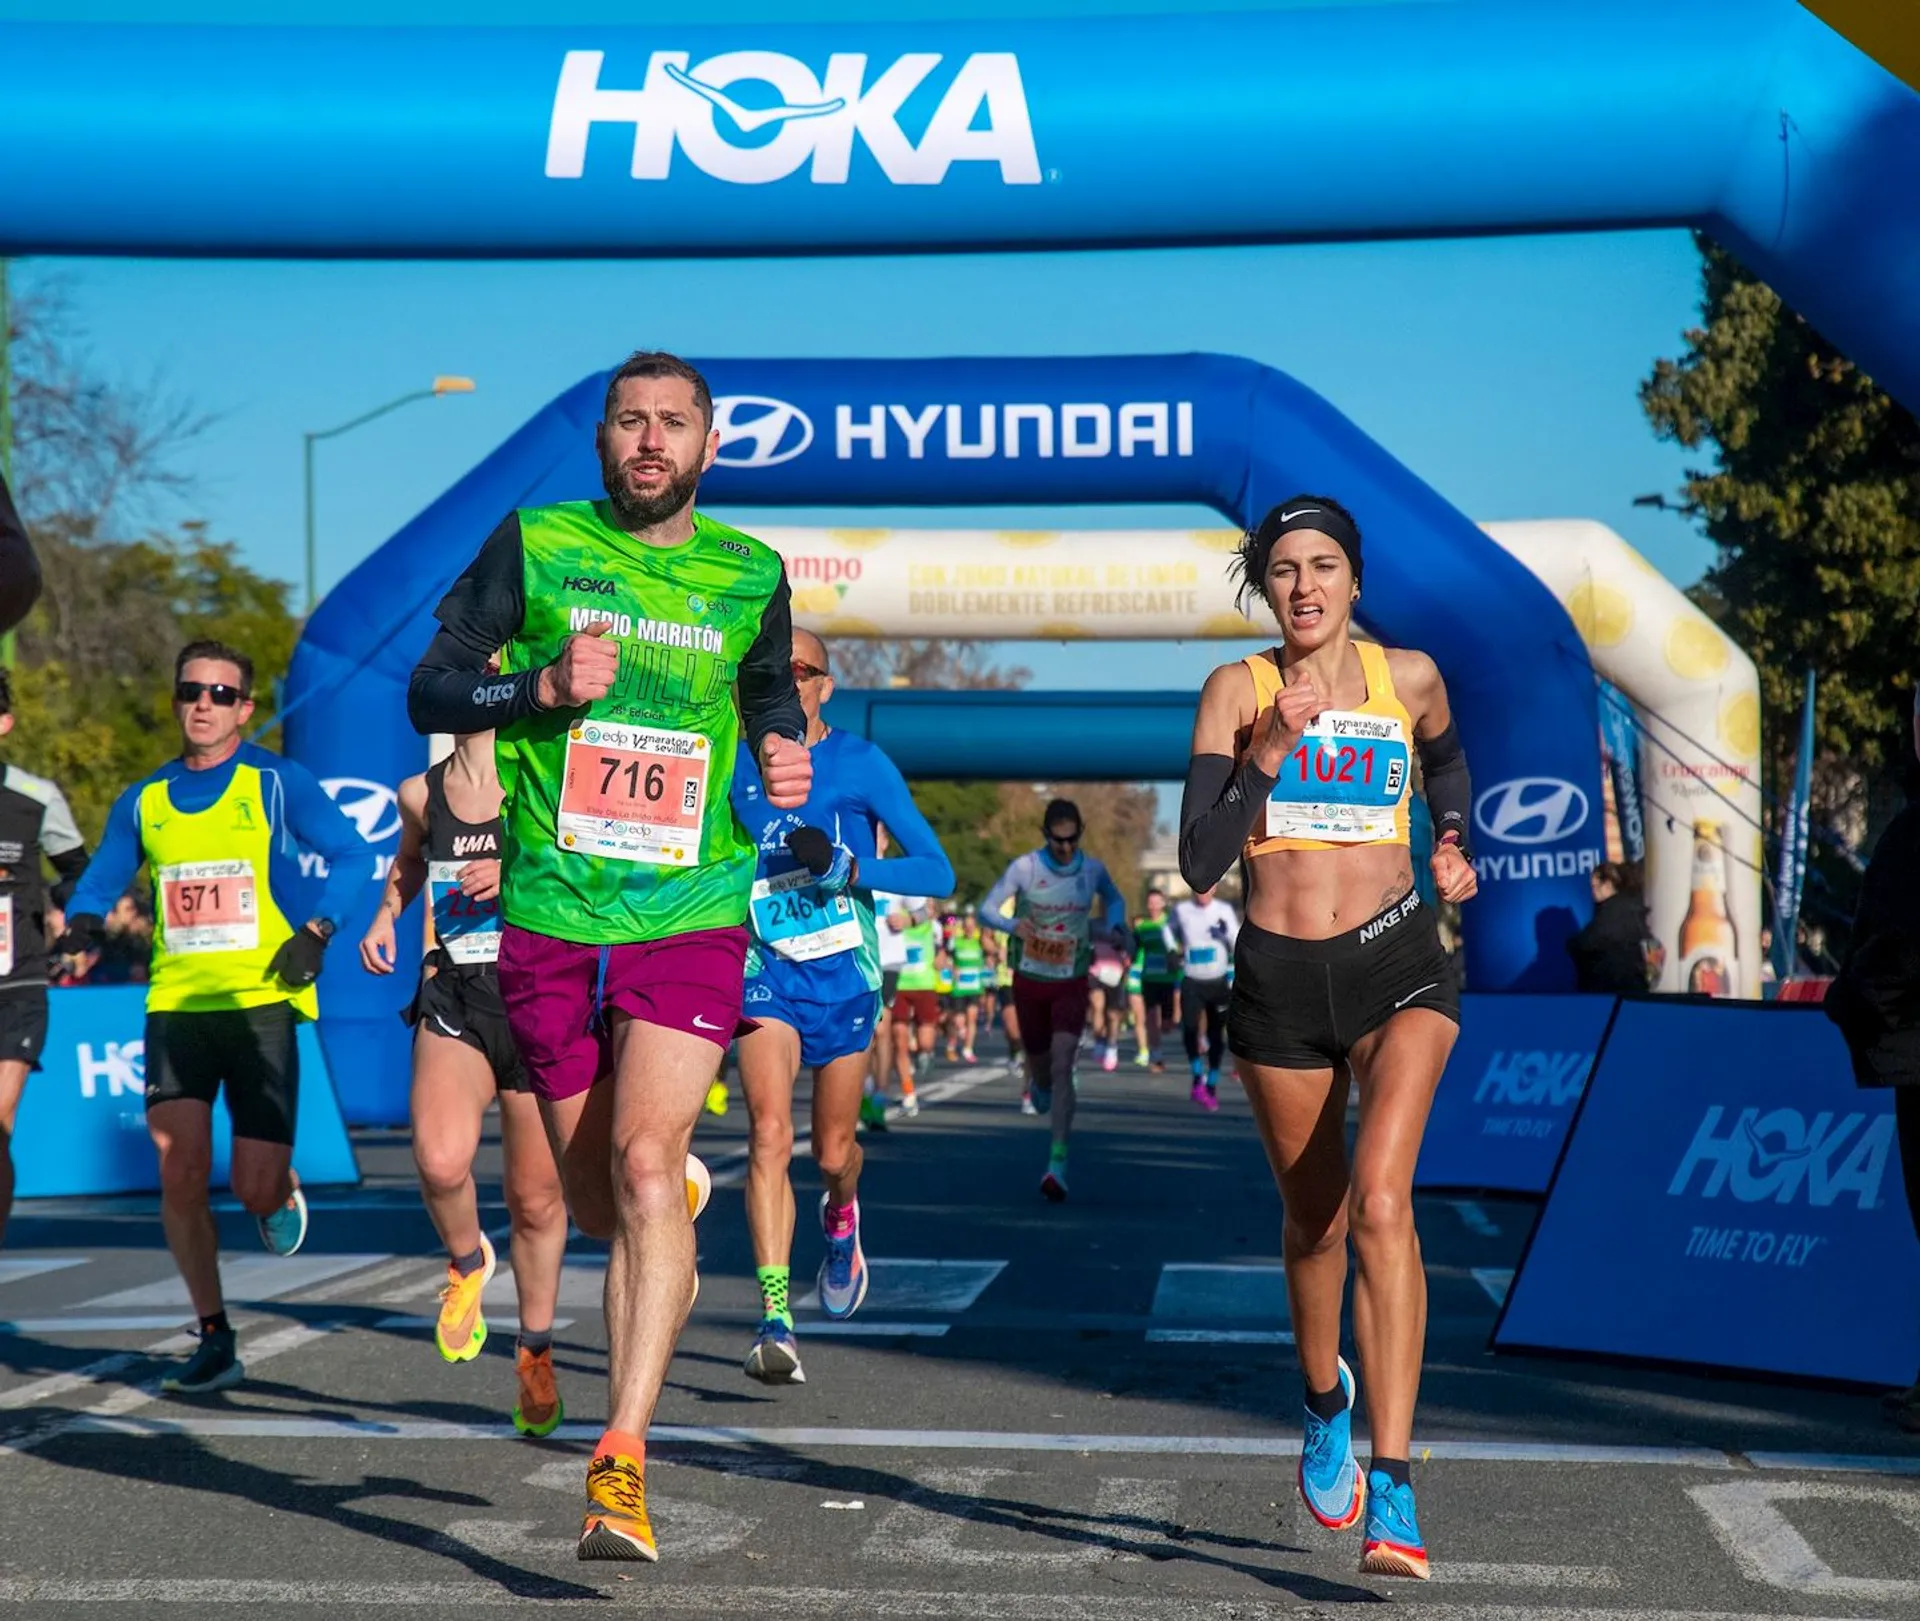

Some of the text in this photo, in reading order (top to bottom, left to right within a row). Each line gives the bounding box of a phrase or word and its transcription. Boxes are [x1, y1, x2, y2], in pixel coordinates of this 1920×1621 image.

[545, 50, 1043, 184] HOKA
[835, 401, 1193, 459] HYUNDAI
[718, 539, 751, 557] 2023
[562, 576, 616, 596] HOKA
[1105, 564, 1129, 587] DE
[706, 598, 733, 616] edp
[909, 589, 1198, 615] DOBLEMENTE REFRESCANTE
[637, 618, 723, 654] MARATÓN
[602, 730, 628, 747] edp
[600, 757, 665, 801] 716
[1294, 744, 1374, 784] 1021
[628, 824, 652, 837] edp
[1472, 849, 1600, 881] HYUNDAI
[181, 884, 220, 912] 571
[1359, 908, 1401, 944] NIKE
[1472, 1050, 1596, 1107] HOKA
[1667, 1105, 1897, 1210] HOKA
[1685, 1226, 1820, 1267] TIME TO FLY
